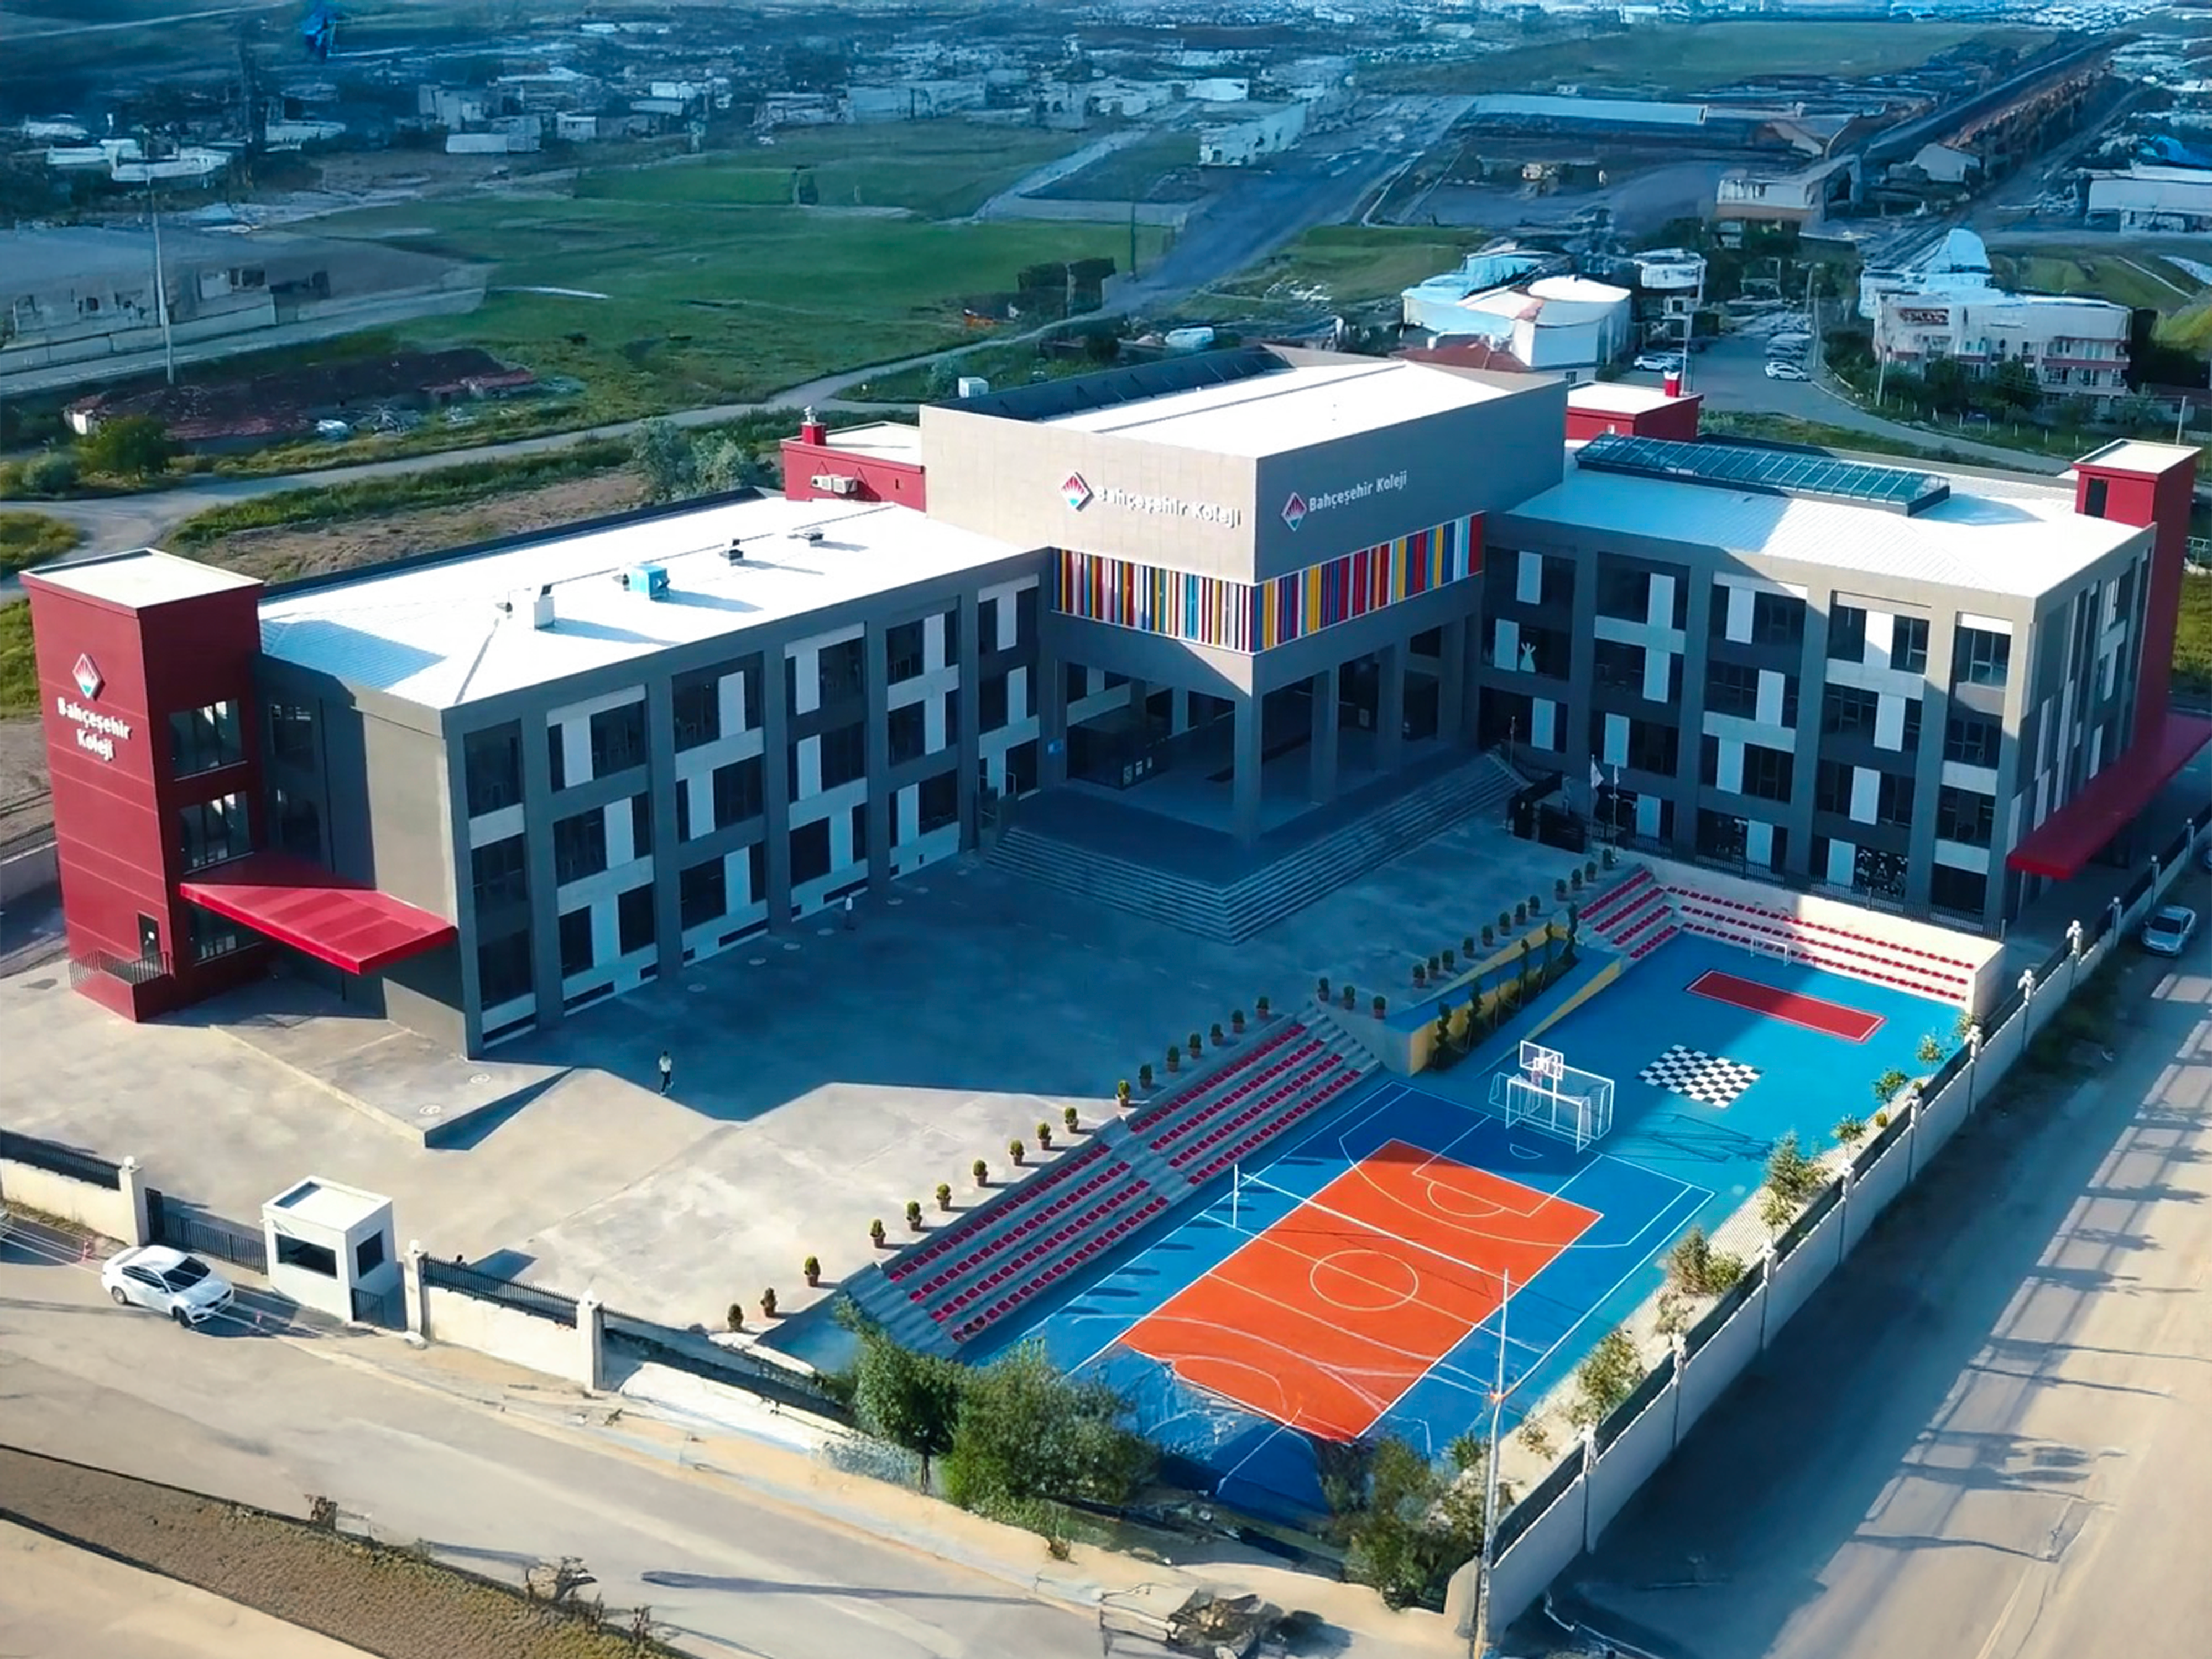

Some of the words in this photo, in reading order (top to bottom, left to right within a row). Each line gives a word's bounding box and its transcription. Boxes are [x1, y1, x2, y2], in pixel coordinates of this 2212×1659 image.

[1309, 481, 1373, 512] Bahçeşehir
[1376, 470, 1407, 492] Koleji
[57, 696, 131, 740] Bahçeşehir
[76, 728, 114, 761] Koleji
